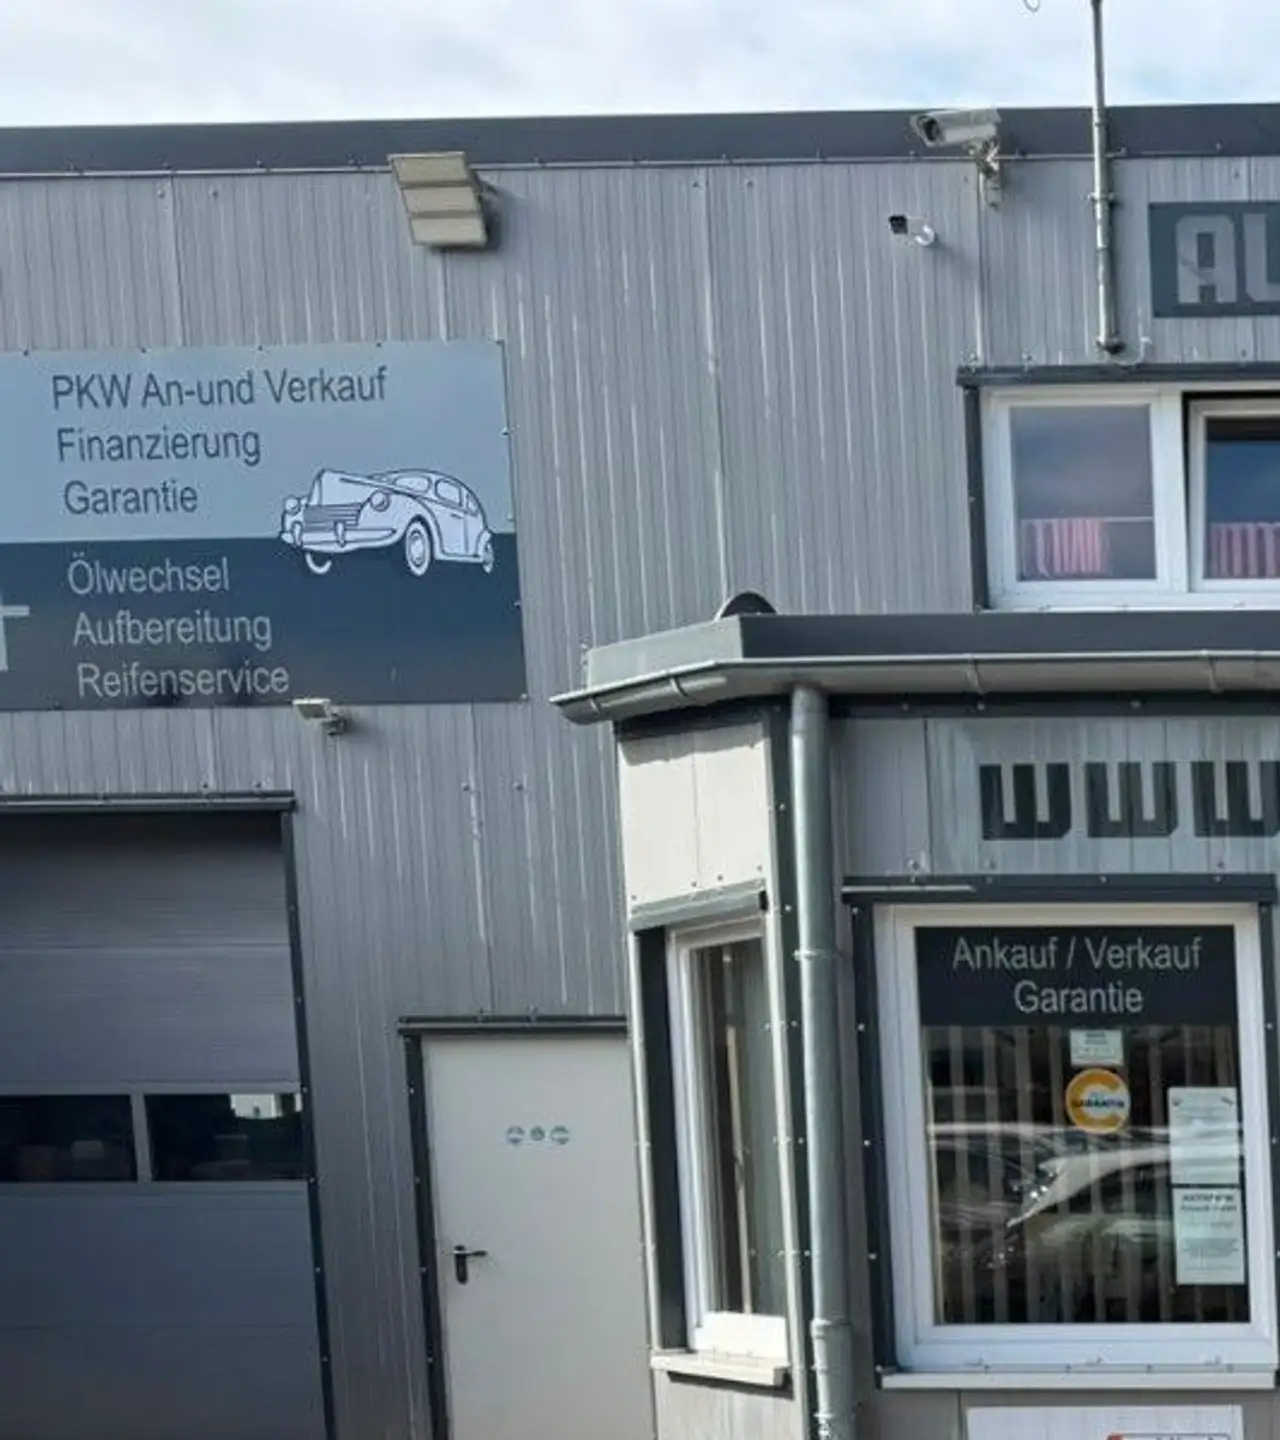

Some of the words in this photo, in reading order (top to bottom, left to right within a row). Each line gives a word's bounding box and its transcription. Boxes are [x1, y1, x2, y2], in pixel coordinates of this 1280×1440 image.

[52, 373, 132, 409] PKW
[142, 370, 255, 408] An-und
[264, 366, 388, 405] Verkauf
[57, 424, 262, 466] Finanzierung
[64, 479, 198, 515] Garantie
[67, 551, 230, 596] Ölwechsel
[73, 609, 272, 651] Aufbereitung
[77, 658, 289, 699] Reifenservice
[952, 935, 1060, 971] Ankauf
[1087, 933, 1202, 970] Verkauf
[1014, 979, 1143, 1014] Garantie
